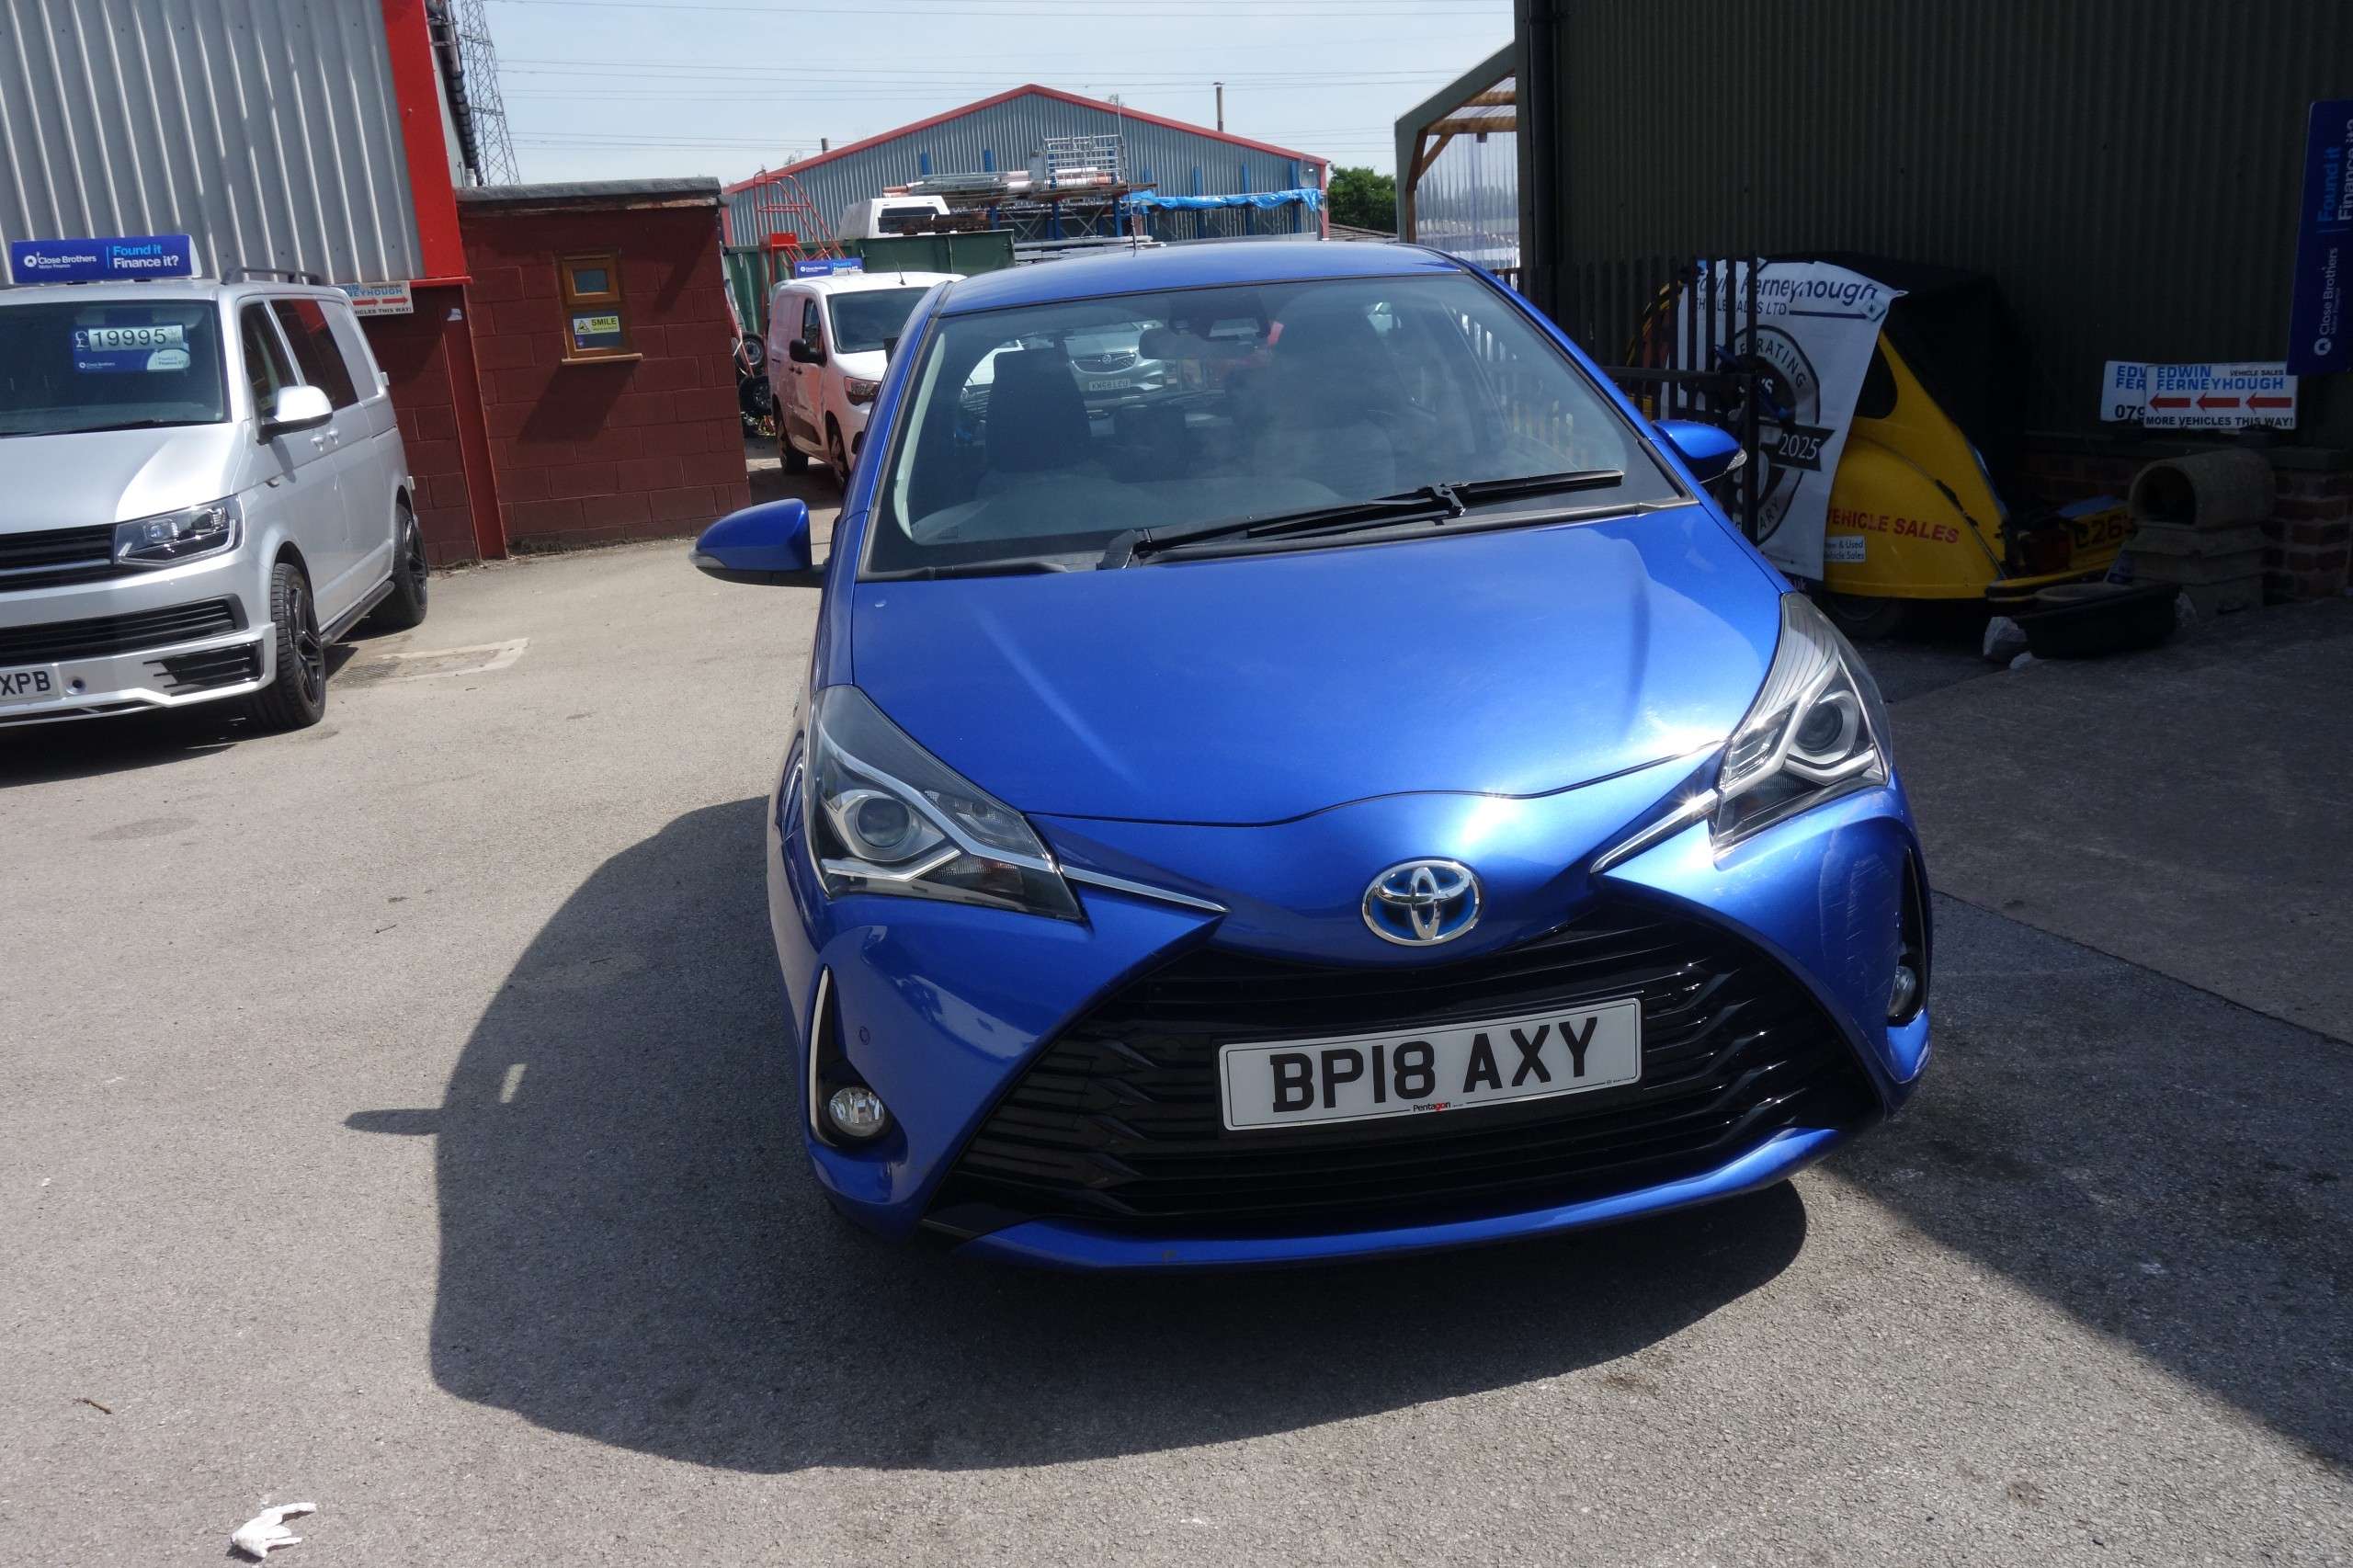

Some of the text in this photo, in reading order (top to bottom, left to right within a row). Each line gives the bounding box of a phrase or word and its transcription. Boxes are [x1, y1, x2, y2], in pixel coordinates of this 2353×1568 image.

[2316, 146, 2341, 222] Found it
[114, 244, 162, 256] Found it
[38, 255, 97, 265] Close Brothers
[114, 256, 179, 268] Finance it?
[2319, 247, 2338, 336] Close Brothers
[1766, 301, 1787, 315] LTD
[591, 317, 617, 326] SMILE
[2156, 366, 2211, 378] EDWIN
[2156, 378, 2284, 391] FERNEYHOUGH
[2145, 416, 2293, 427] MORE VEHICLES THIS WAY!
[1779, 433, 1820, 460] 2025
[1893, 517, 1960, 544] SALES
[1846, 540, 1864, 549] Used
[1847, 551, 1864, 560] Sales
[0, 671, 51, 696] XPB
[1269, 1017, 1598, 1113] BP18 AXY
[1413, 1102, 1451, 1112] Pentagon
